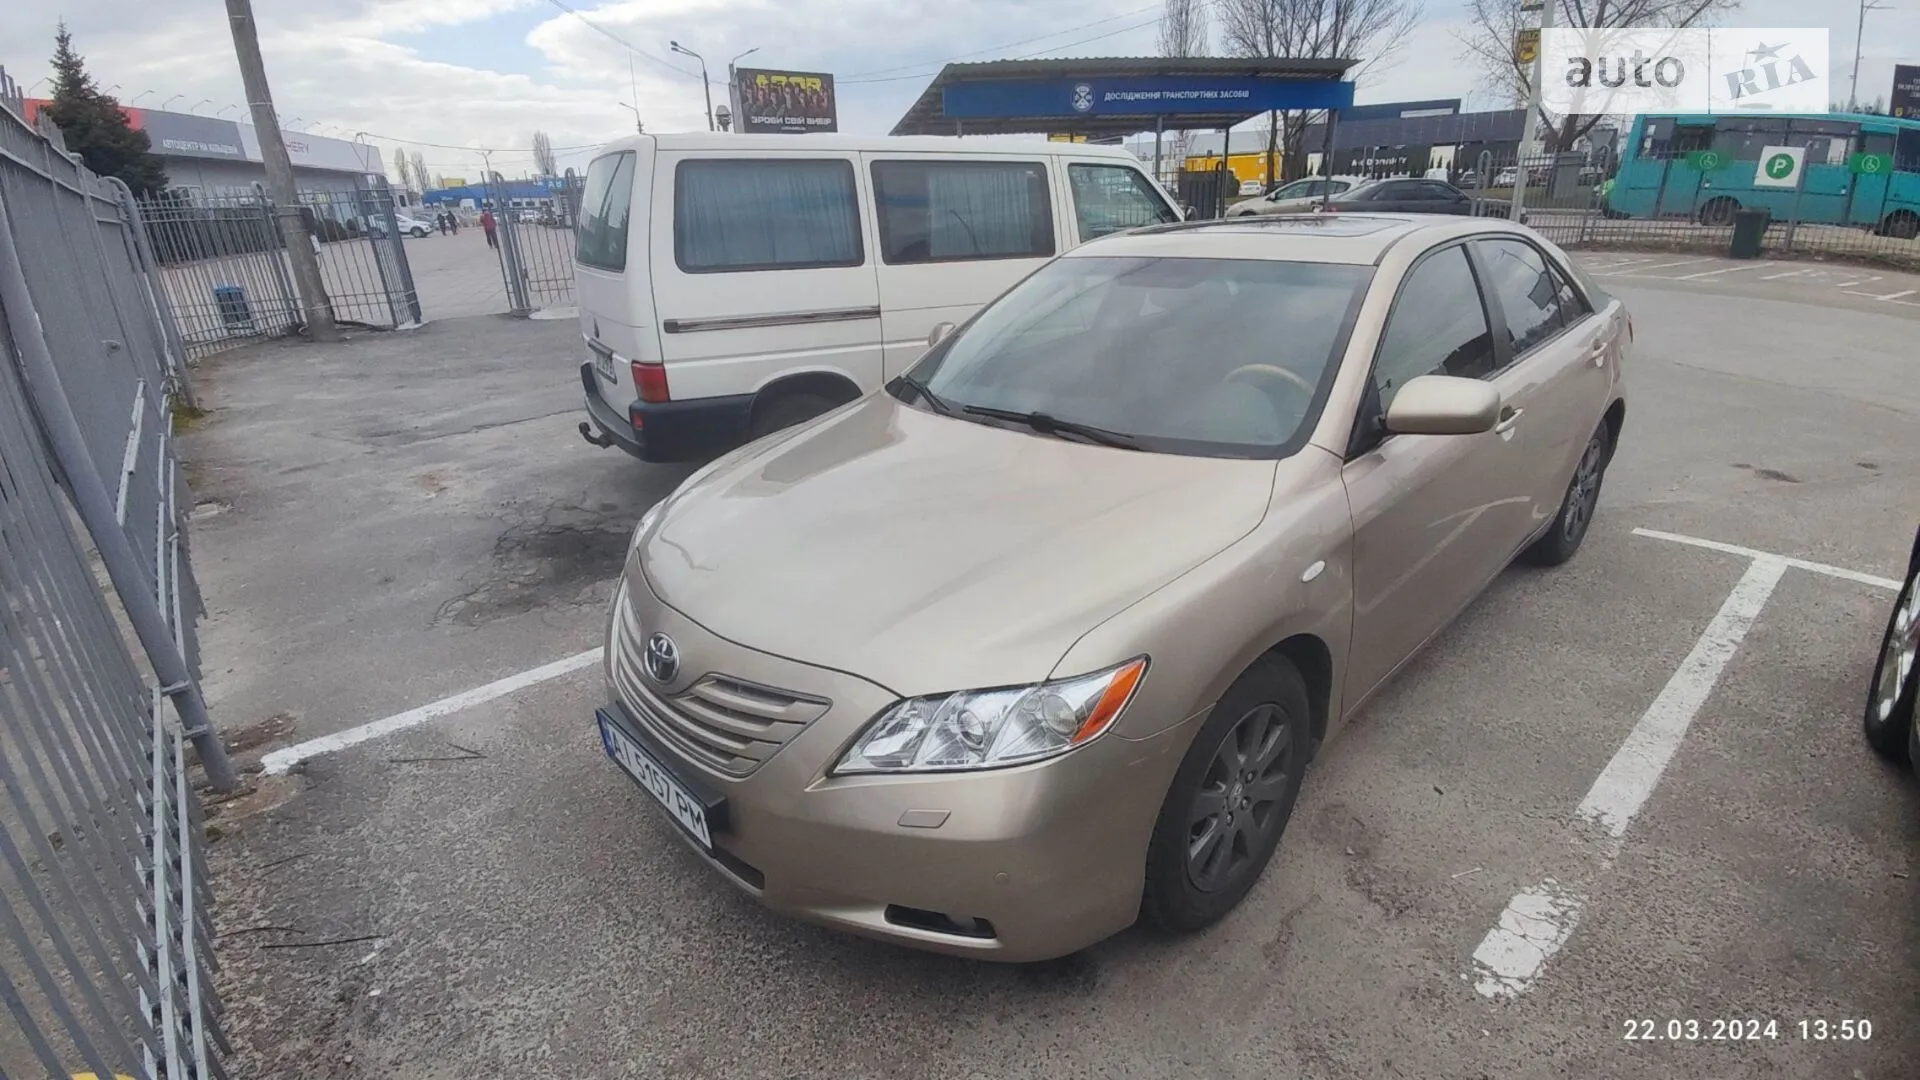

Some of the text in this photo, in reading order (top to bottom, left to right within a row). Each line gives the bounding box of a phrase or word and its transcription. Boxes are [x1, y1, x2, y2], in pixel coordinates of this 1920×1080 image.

[751, 116, 783, 124] ЗРОБИ
[285, 141, 309, 153] HERY
[1772, 157, 1788, 174] P
[635, 752, 670, 804] 5157
[676, 791, 707, 840] PM
